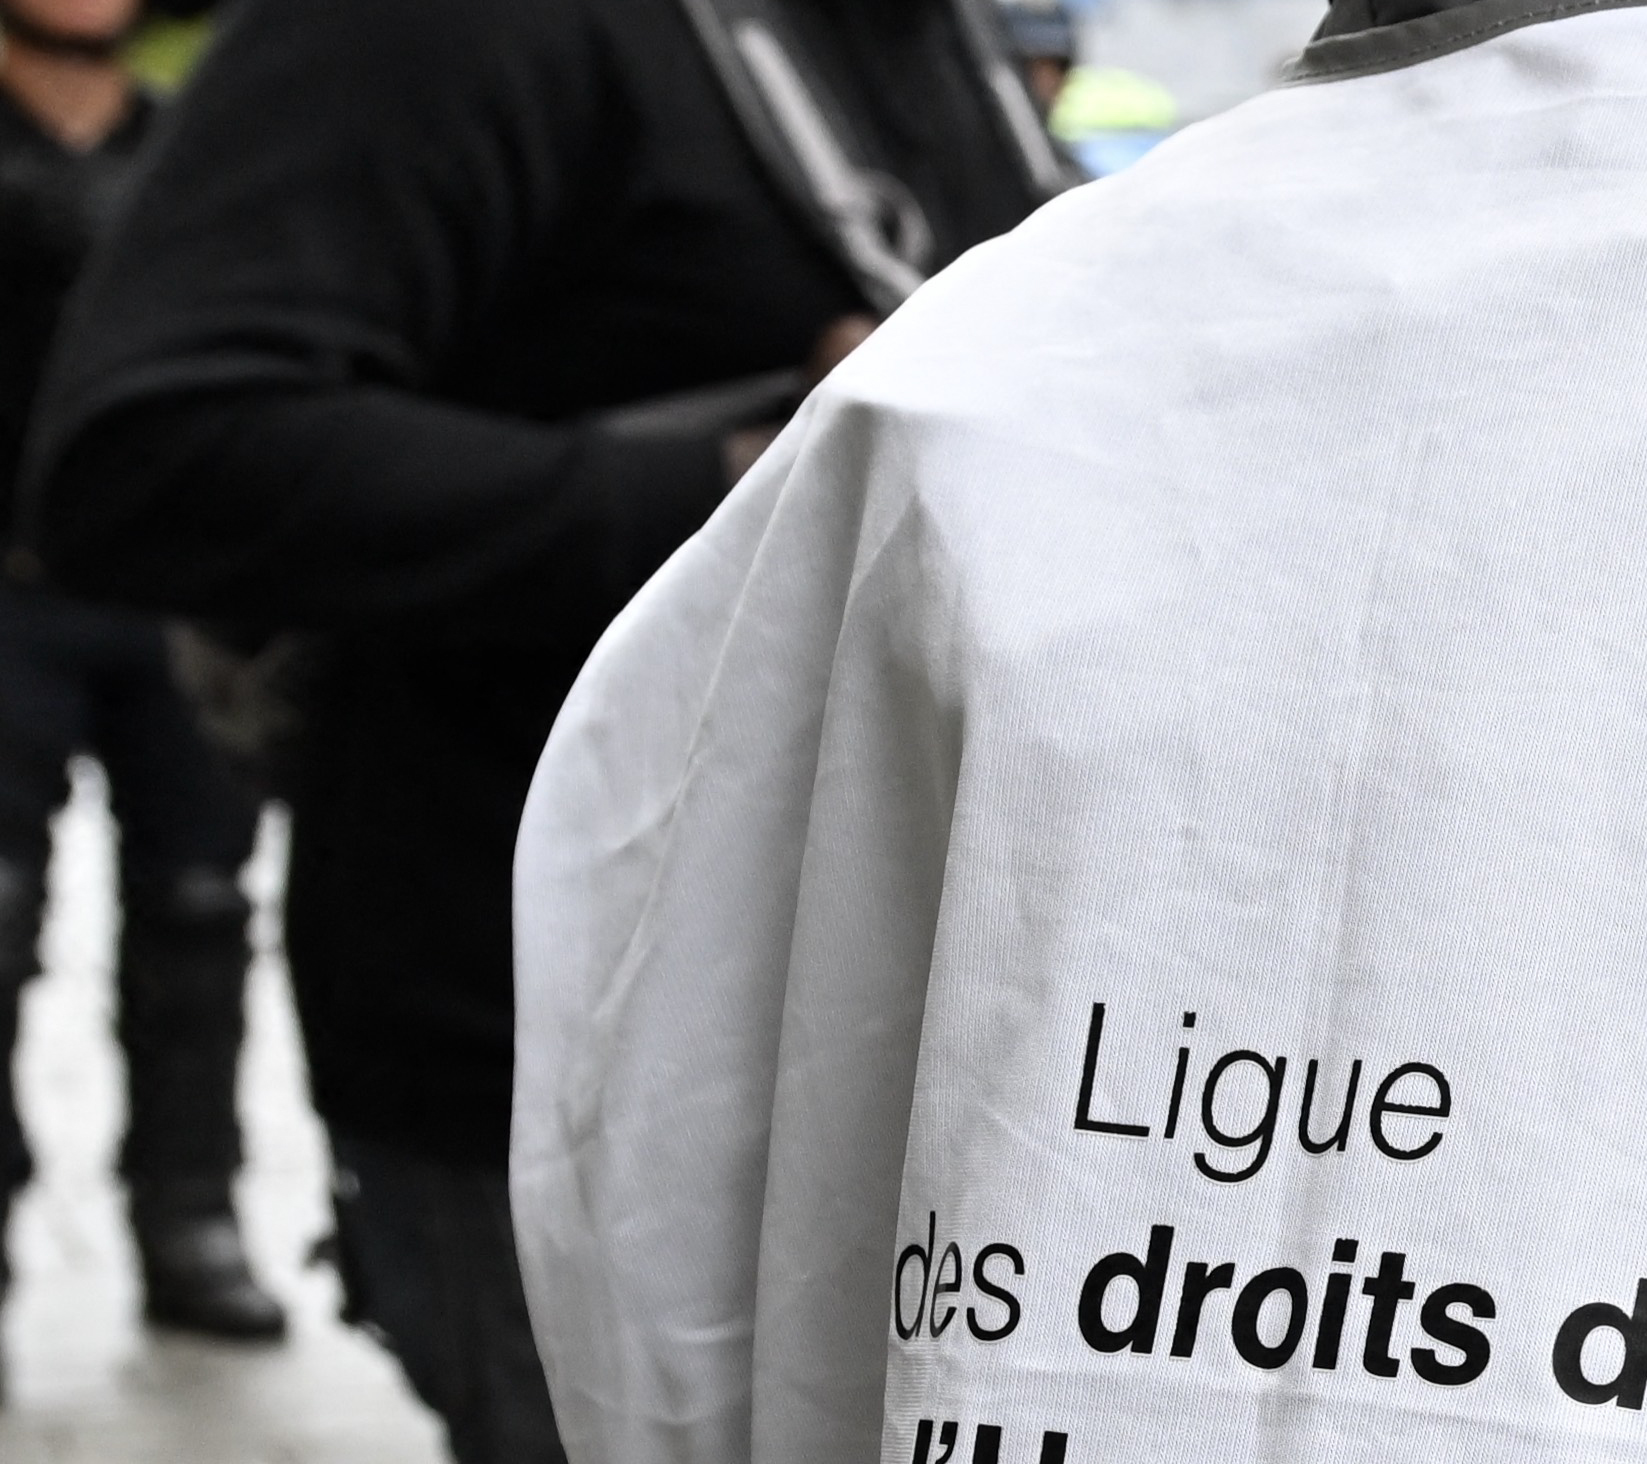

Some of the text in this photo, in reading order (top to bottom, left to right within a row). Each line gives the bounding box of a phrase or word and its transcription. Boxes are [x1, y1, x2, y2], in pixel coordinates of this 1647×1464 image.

[1074, 1003, 1452, 1182] Ligue
[894, 1212, 1025, 1341] des
[1078, 1224, 1496, 1386] droits
